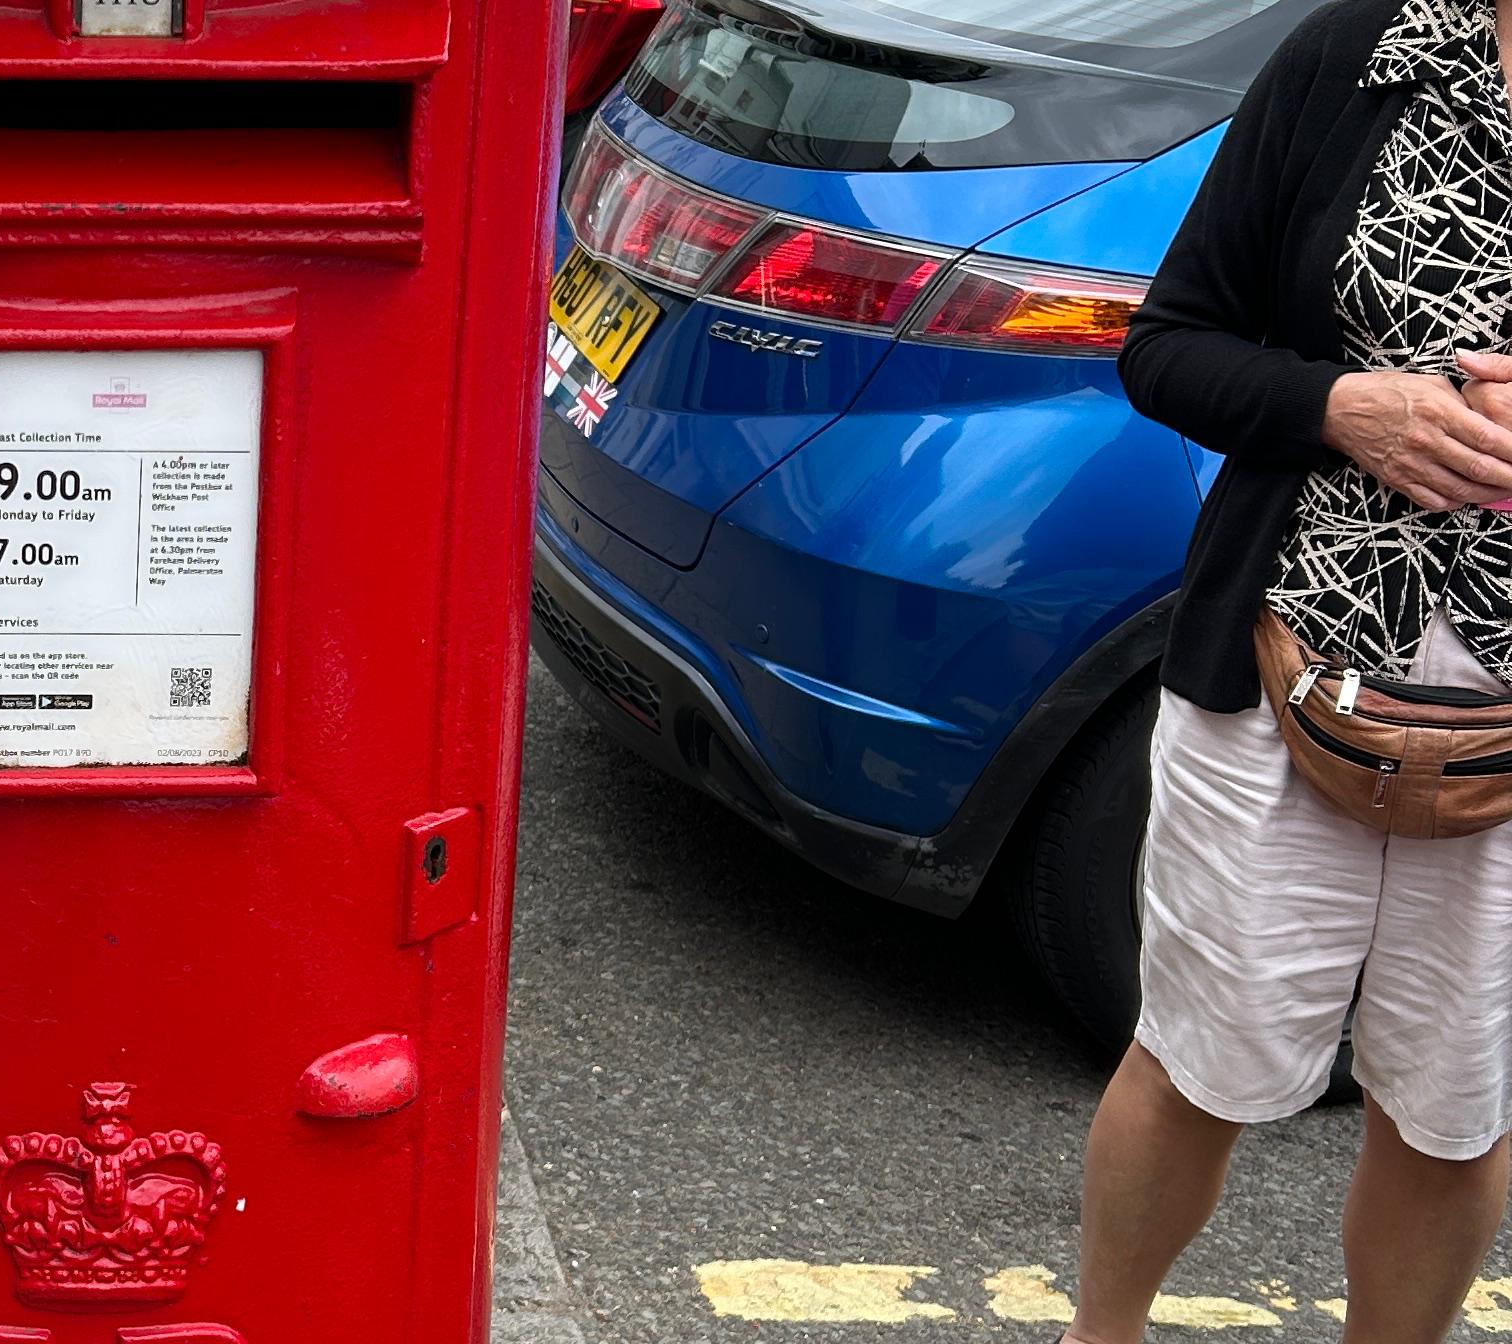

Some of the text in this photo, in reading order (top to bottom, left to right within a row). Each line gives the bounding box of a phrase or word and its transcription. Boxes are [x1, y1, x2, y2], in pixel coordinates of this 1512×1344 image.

[585, 284, 650, 364] RFY
[709, 321, 823, 357] CIVIC
[19, 433, 71, 443] Collection
[75, 433, 102, 443] Time
[211, 461, 230, 469] later
[153, 472, 225, 480] collection is made
[152, 493, 209, 501] Wickham Post
[42, 510, 53, 521] to
[59, 509, 95, 523] Friday
[194, 525, 232, 533] collection
[196, 546, 216, 554] from
[187, 557, 220, 565] Delivery
[149, 577, 166, 586] Way
[48, 653, 62, 661] app
[4, 662, 35, 671] locating
[47, 672, 59, 680] QR
